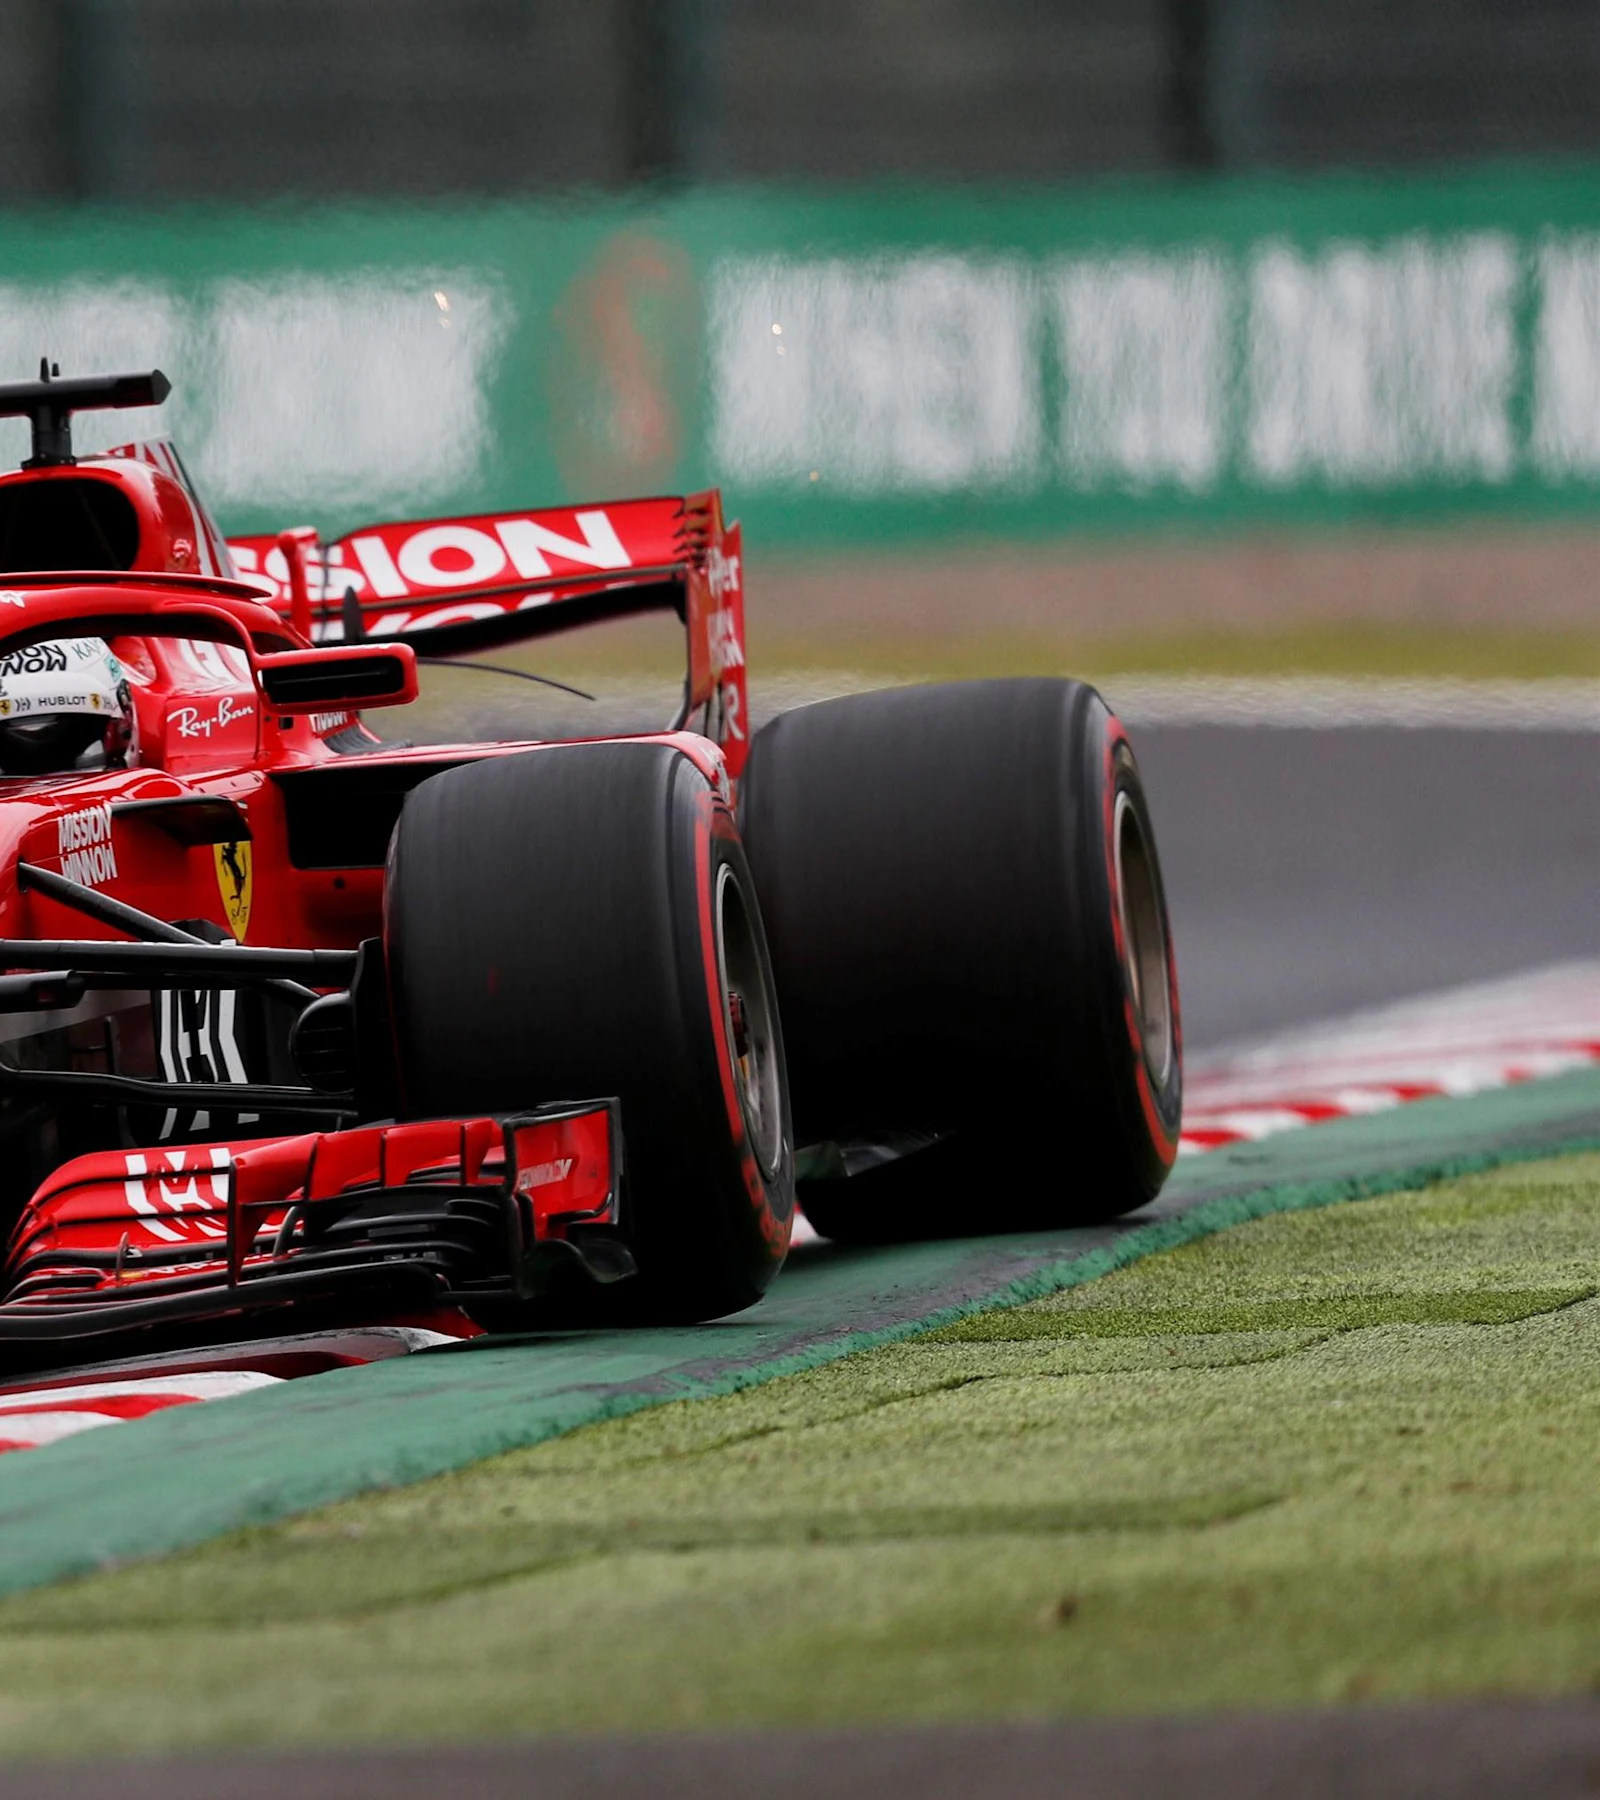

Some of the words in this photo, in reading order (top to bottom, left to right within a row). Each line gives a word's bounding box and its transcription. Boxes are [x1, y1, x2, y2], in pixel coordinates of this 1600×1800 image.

[38, 696, 87, 707] HUBLOT
[166, 696, 254, 737] Ray-Ban
[58, 803, 112, 855] MISSION
[59, 841, 118, 887] WINNOW
